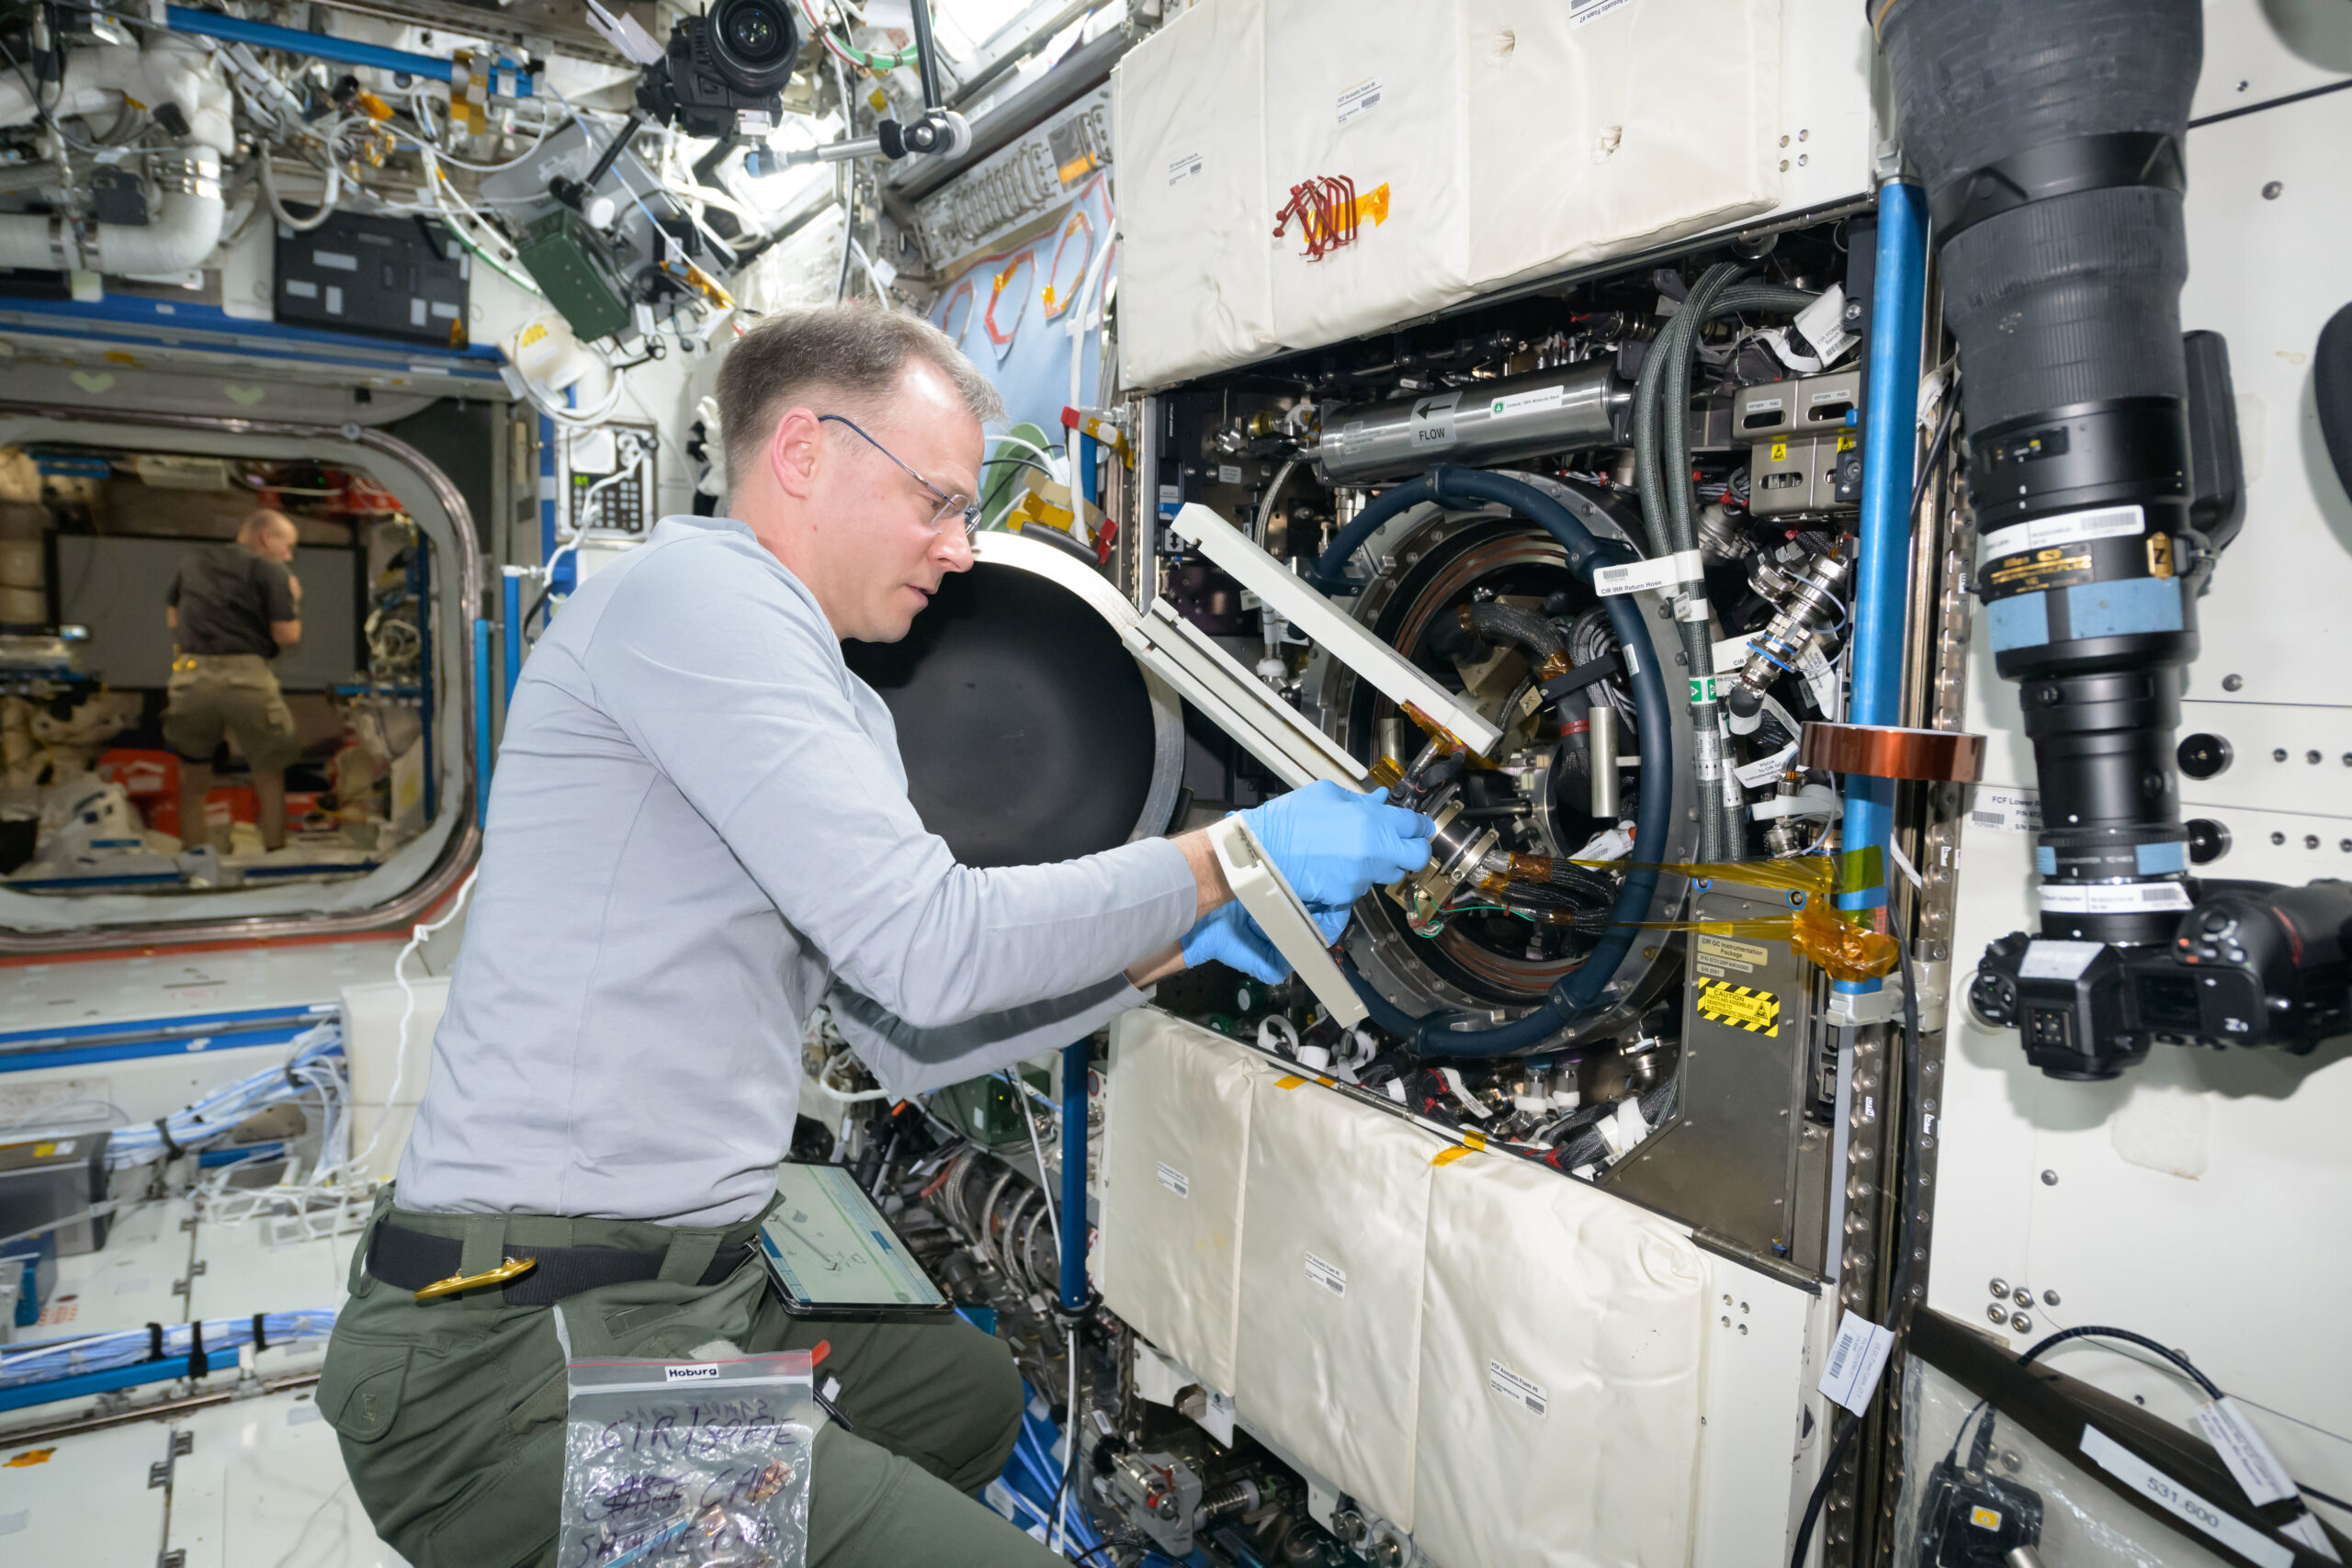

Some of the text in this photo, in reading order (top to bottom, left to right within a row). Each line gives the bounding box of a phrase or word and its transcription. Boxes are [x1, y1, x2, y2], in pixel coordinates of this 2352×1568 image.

[1419, 428, 1445, 441] FLOW
[2008, 797, 2033, 806] Lower
[1720, 949, 1743, 959] Package
[1722, 942, 1763, 955] Instrumentation
[1714, 990, 1745, 1002] CAUTION
[669, 1367, 717, 1378] Hoburg
[2146, 1475, 2221, 1529] 531.600
